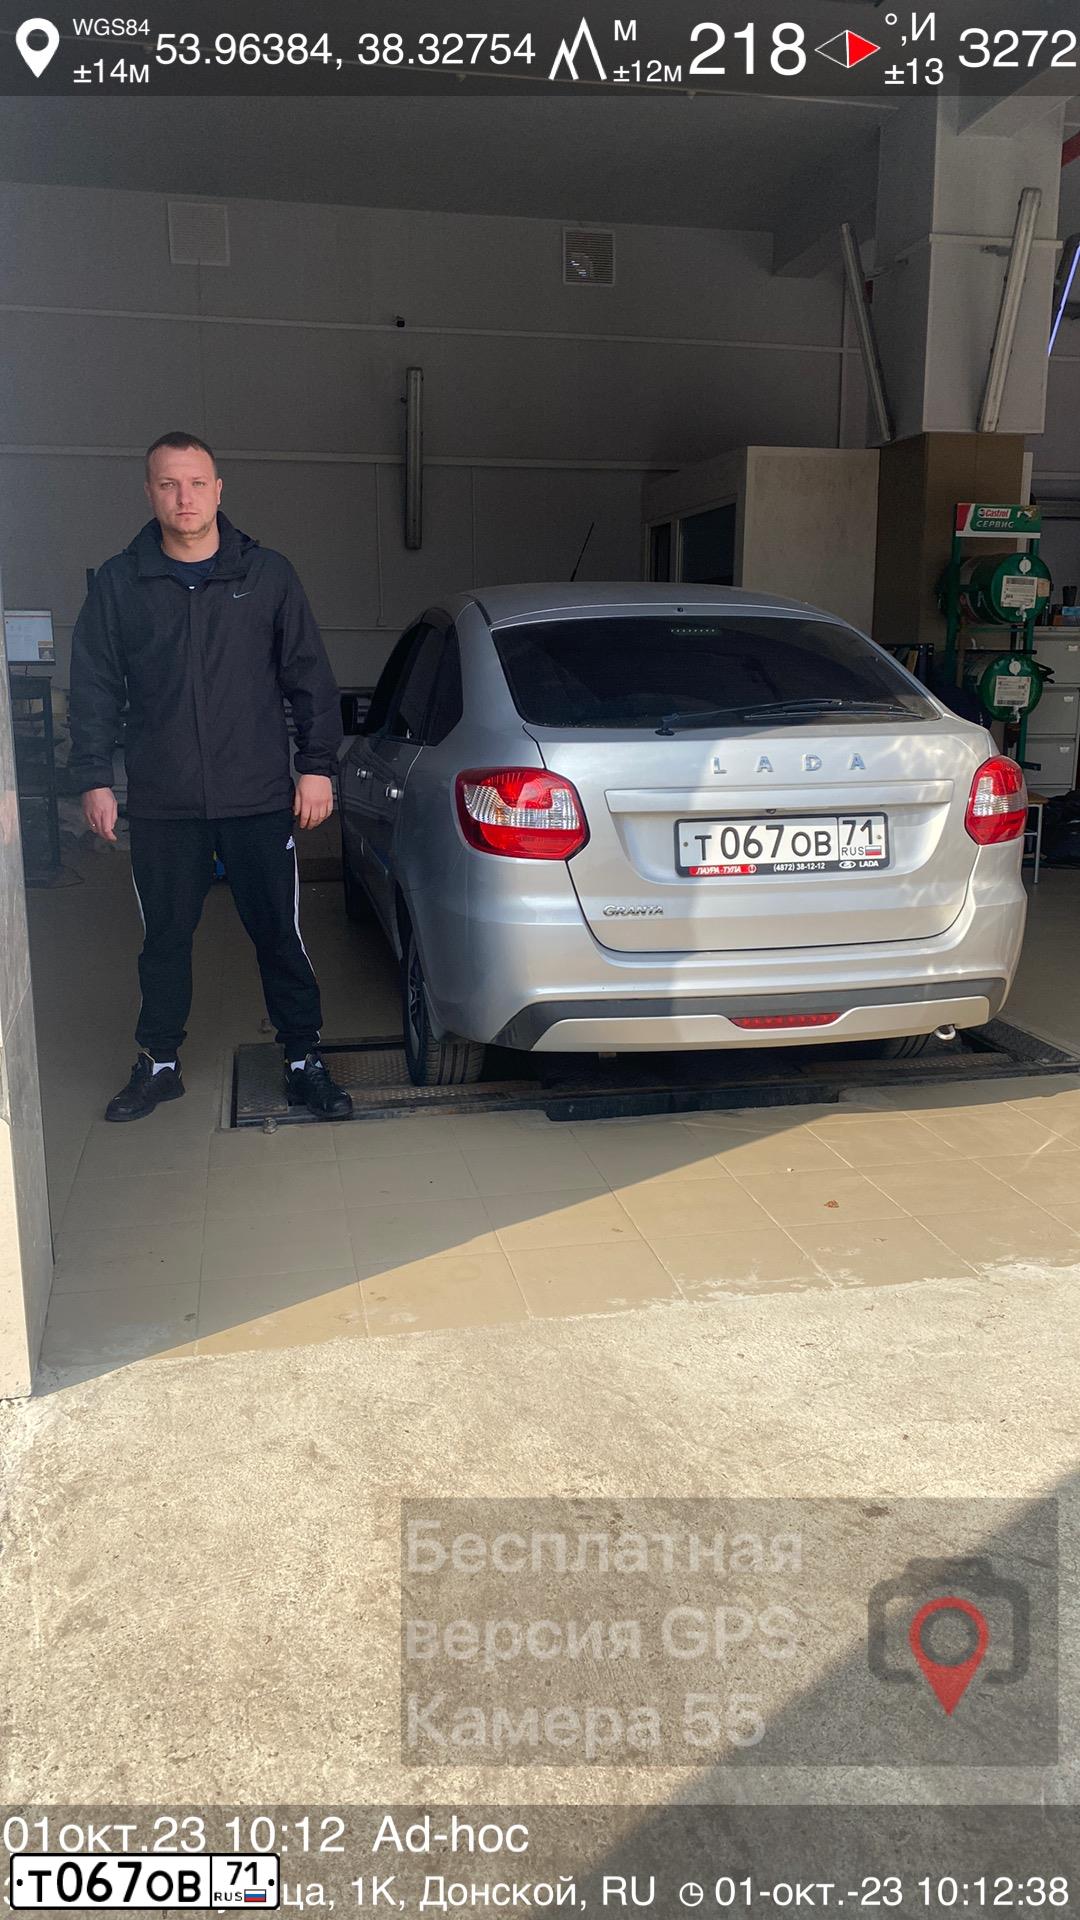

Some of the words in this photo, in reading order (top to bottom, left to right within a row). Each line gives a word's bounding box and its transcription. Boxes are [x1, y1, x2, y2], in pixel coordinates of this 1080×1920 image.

[985, 509, 1009, 518] Castrol
[976, 520, 1015, 529] СЕРВИС
[712, 753, 866, 774] LADA
[842, 818, 873, 846] 71
[841, 846, 865, 857] RUS
[858, 860, 880, 868] LADA
[602, 904, 664, 917] GRANTA
